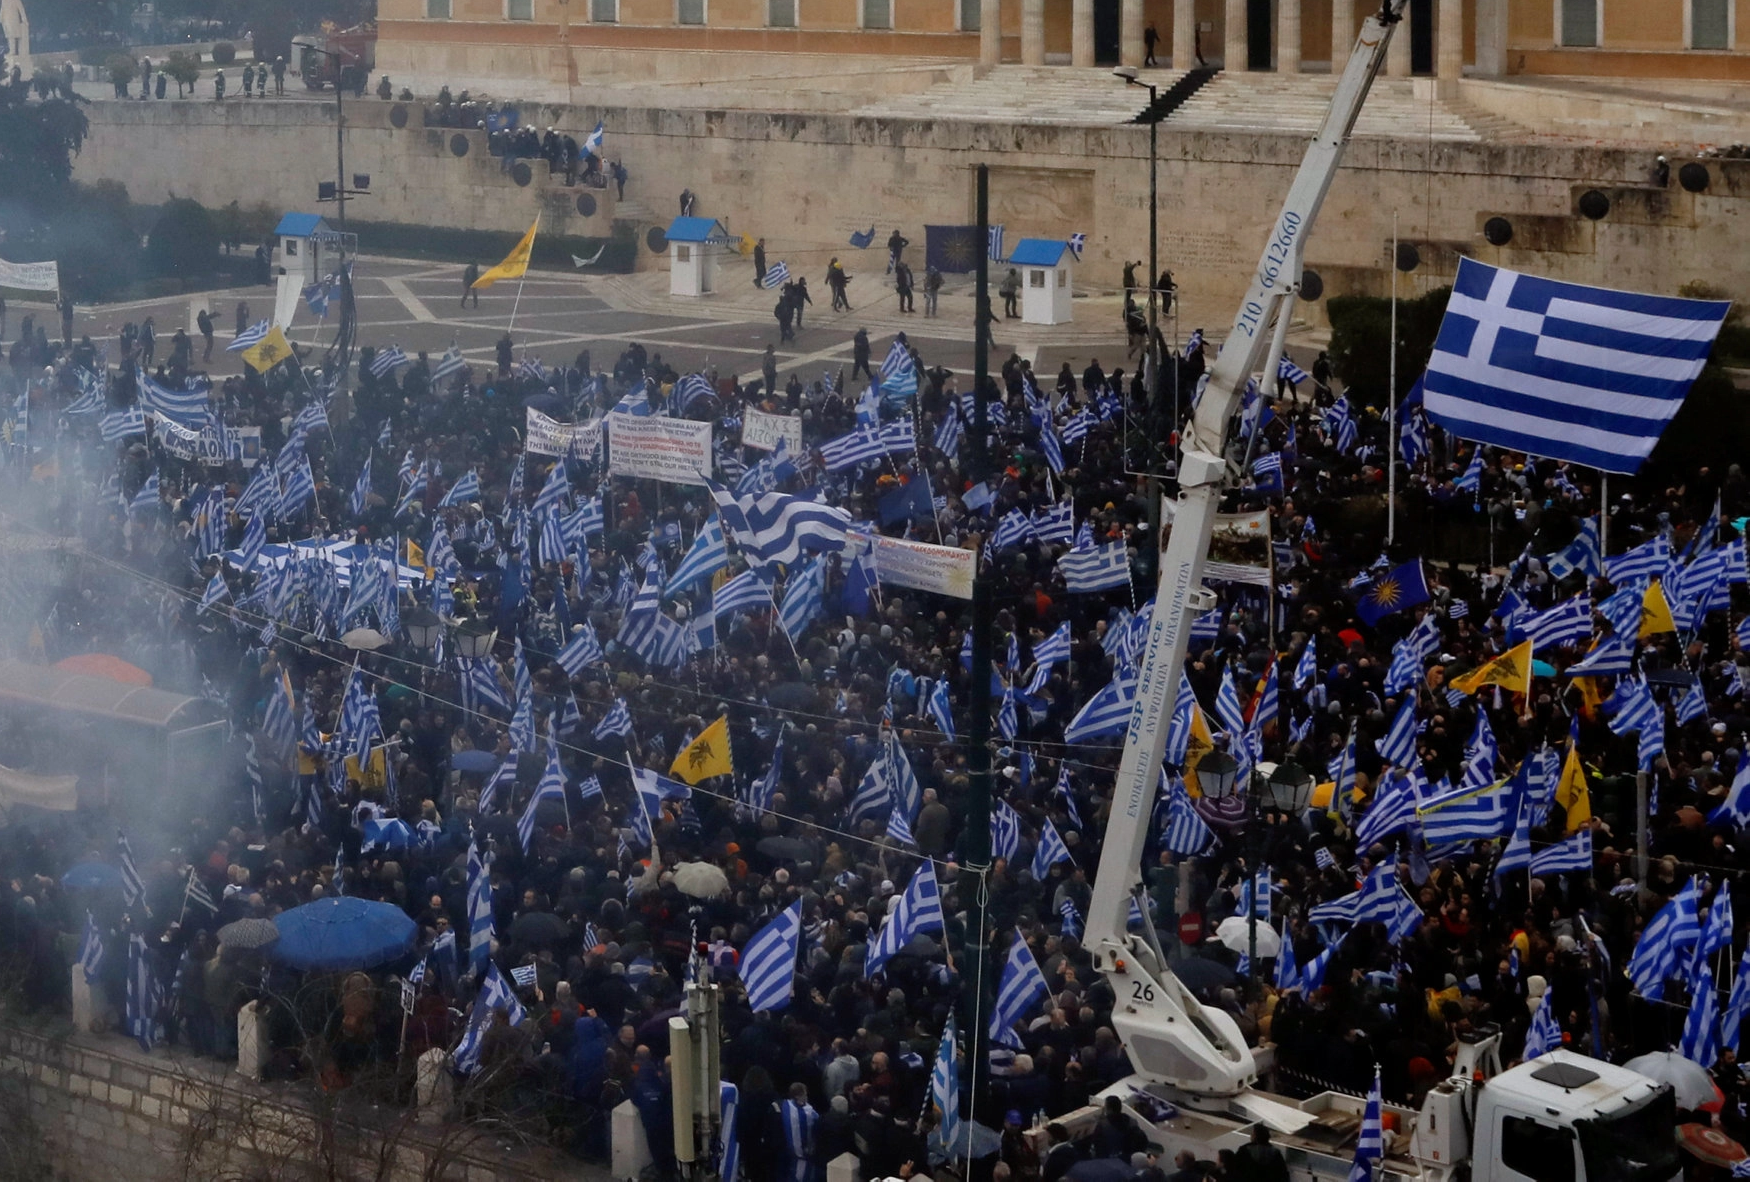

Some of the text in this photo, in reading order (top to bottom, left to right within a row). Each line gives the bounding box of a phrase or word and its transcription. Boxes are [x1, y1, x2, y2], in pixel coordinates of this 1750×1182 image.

[1237, 301, 1263, 338] 210
[1260, 210, 1301, 290] 6612660
[1128, 619, 1164, 746] JSP SERVICE
[1145, 661, 1170, 736] ΑΝΥΨΩΤΙΚΩΝ
[1163, 560, 1192, 650] ΜΗΧΑΝΗΜΑΤΩΝ
[1132, 980, 1155, 1002] 26
